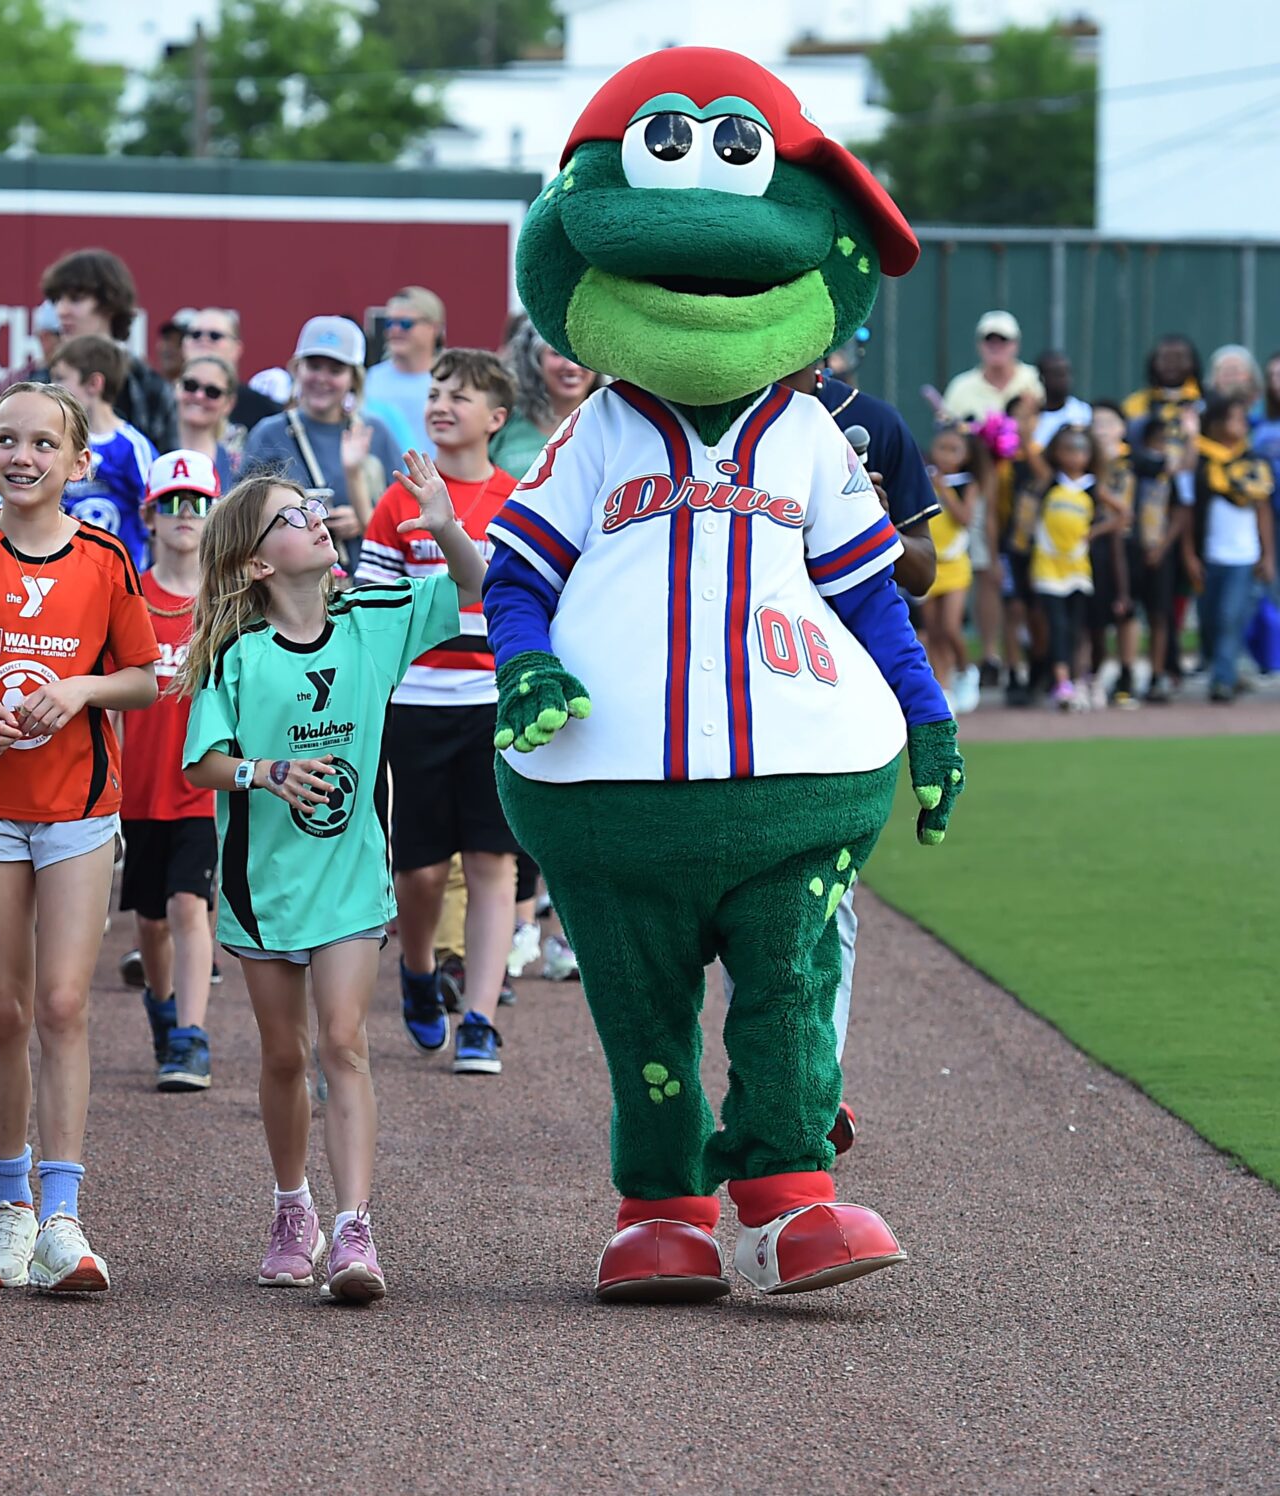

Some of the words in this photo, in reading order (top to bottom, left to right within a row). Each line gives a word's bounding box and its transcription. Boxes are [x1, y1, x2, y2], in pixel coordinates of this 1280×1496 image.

[172, 458, 189, 478] A
[602, 459, 806, 534] Drive
[6, 593, 22, 604] the
[4, 632, 80, 652] WALDROP
[755, 605, 838, 687] 06
[3, 647, 35, 655] PLUMBING
[40, 650, 67, 658] HEATING
[0, 662, 22, 675] RESPECT
[297, 692, 312, 702] the
[287, 720, 356, 741] Waldrop
